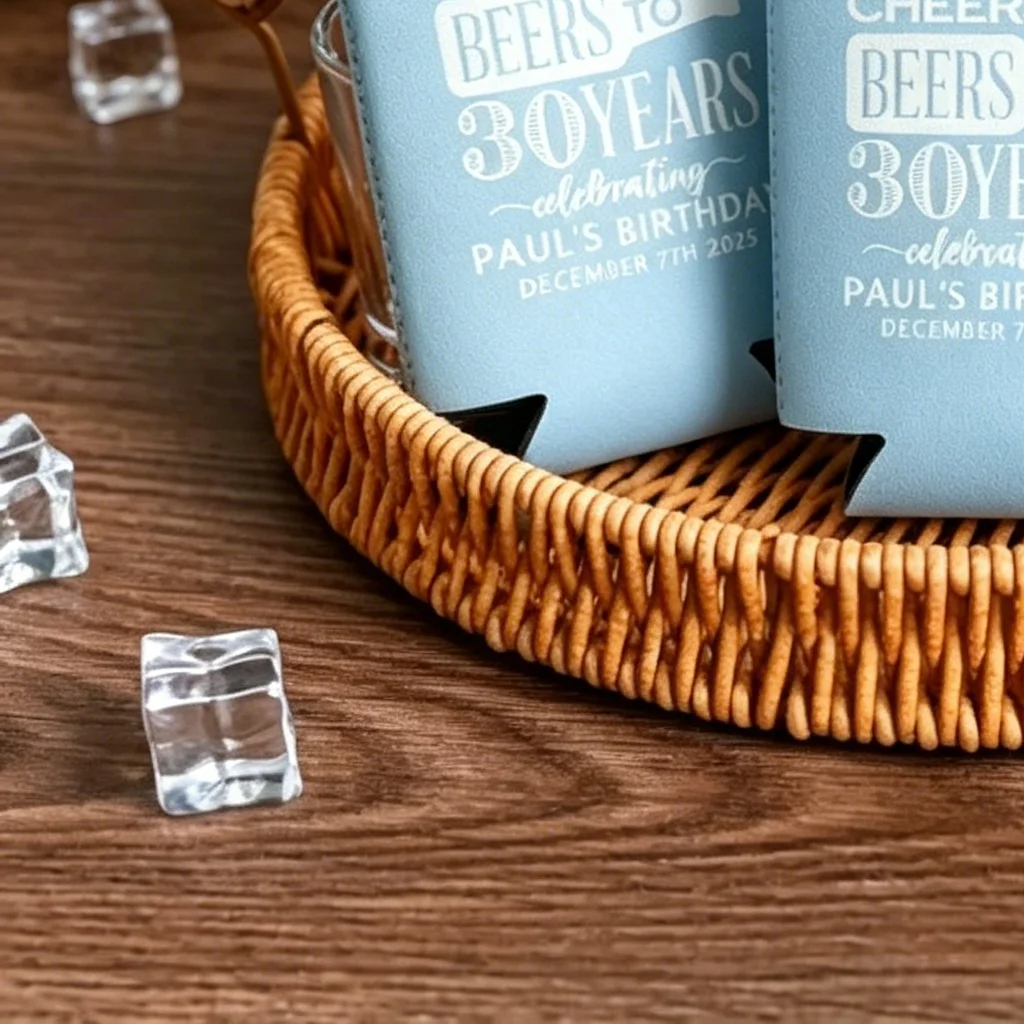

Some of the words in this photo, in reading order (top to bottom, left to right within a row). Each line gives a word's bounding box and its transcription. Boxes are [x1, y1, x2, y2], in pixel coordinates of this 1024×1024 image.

[861, 49, 1015, 120] BEERS
[531, 157, 708, 219] celebrating
[471, 222, 603, 275] PAUL'S
[519, 254, 648, 300] DECEMBER
[657, 243, 698, 270] 7TH
[706, 228, 759, 259] 2025
[844, 276, 966, 311] PAUL'S
[880, 318, 1006, 341] DECEMBER
